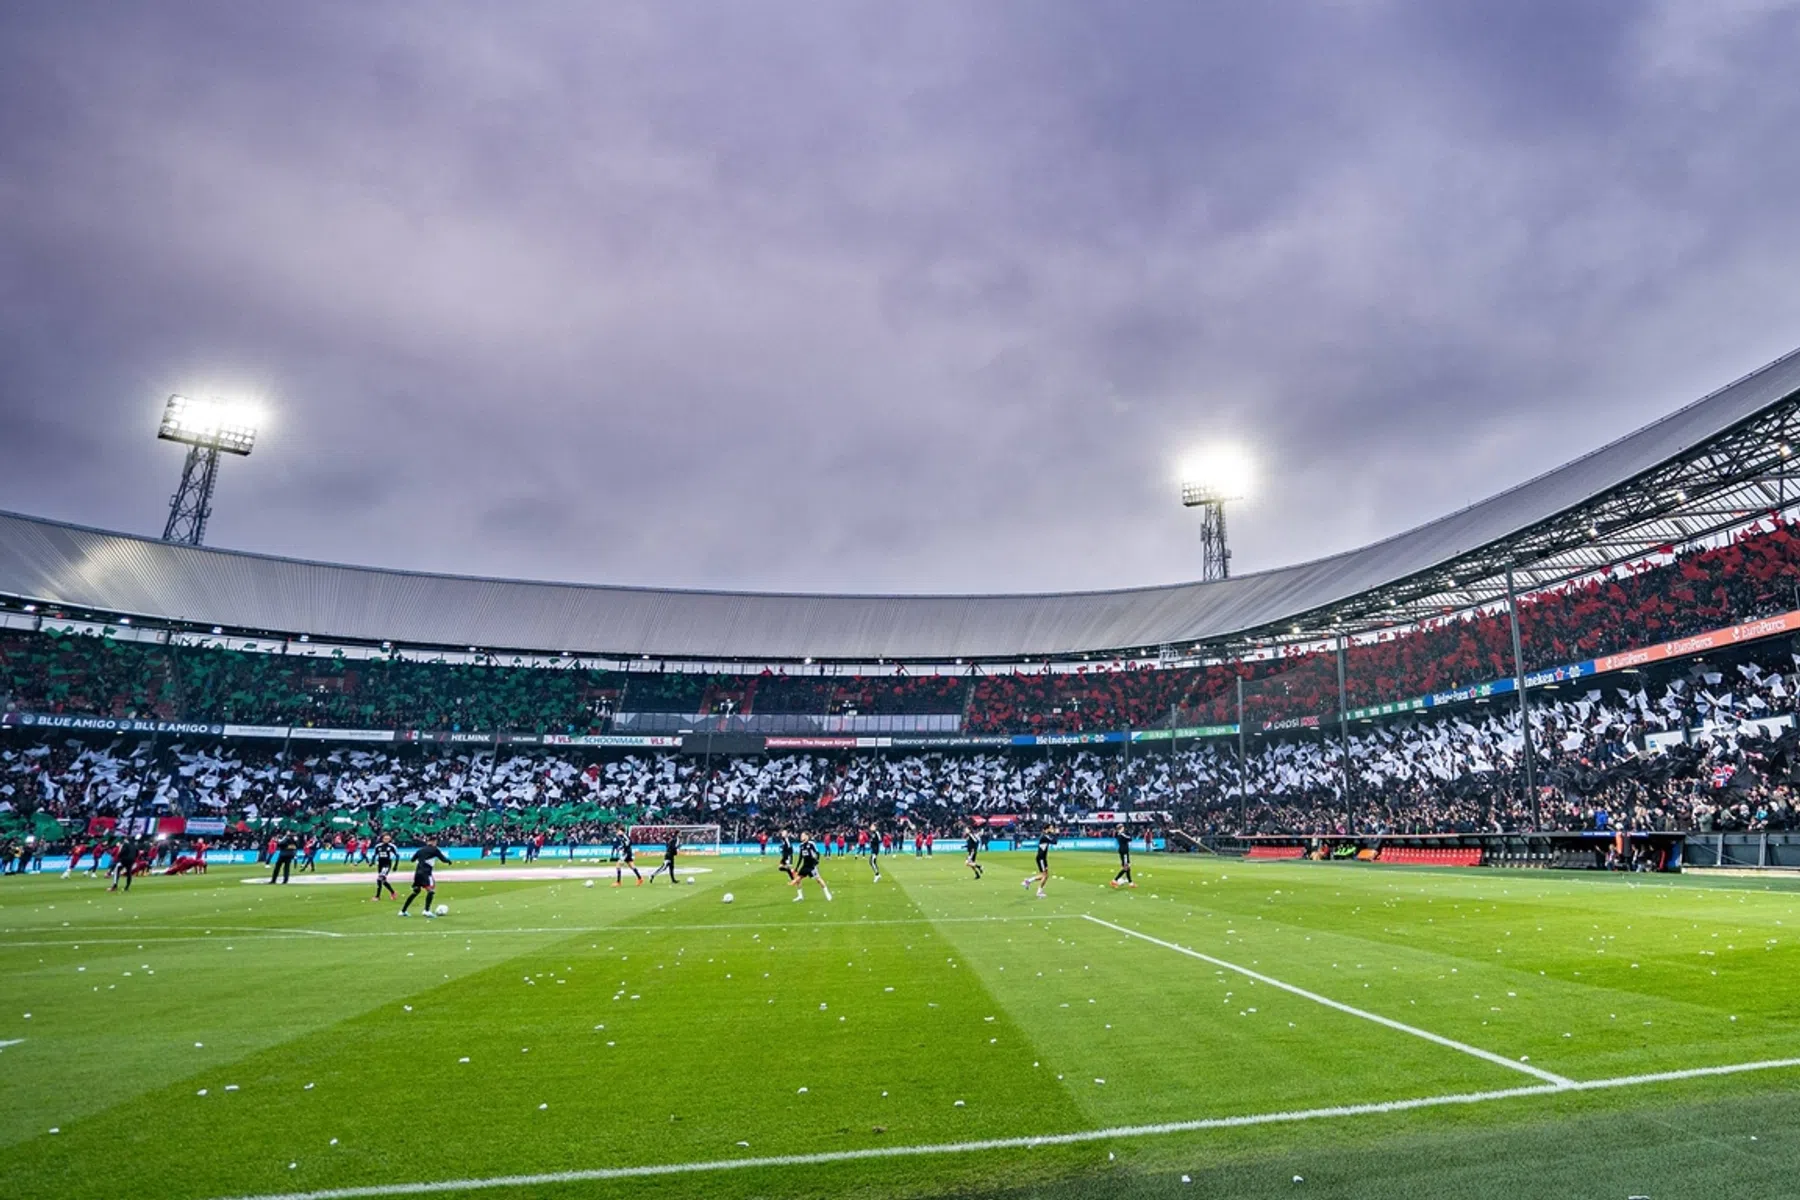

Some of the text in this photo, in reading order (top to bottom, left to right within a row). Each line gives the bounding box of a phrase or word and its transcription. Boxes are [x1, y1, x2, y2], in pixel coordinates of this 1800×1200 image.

[1742, 619, 1785, 638] EuroParcs
[1673, 637, 1713, 652] EuroParcs
[1613, 652, 1648, 667] EuroParcs
[37, 716, 116, 729] BLUE AMIGO
[167, 724, 208, 733] AMIGO
[451, 733, 490, 742] HELMINK
[558, 735, 664, 745] VLS SCHOONMAAK VLS
[1036, 735, 1079, 745] Heineken
[814, 739, 834, 747] Hague
[834, 739, 855, 747] Airport
